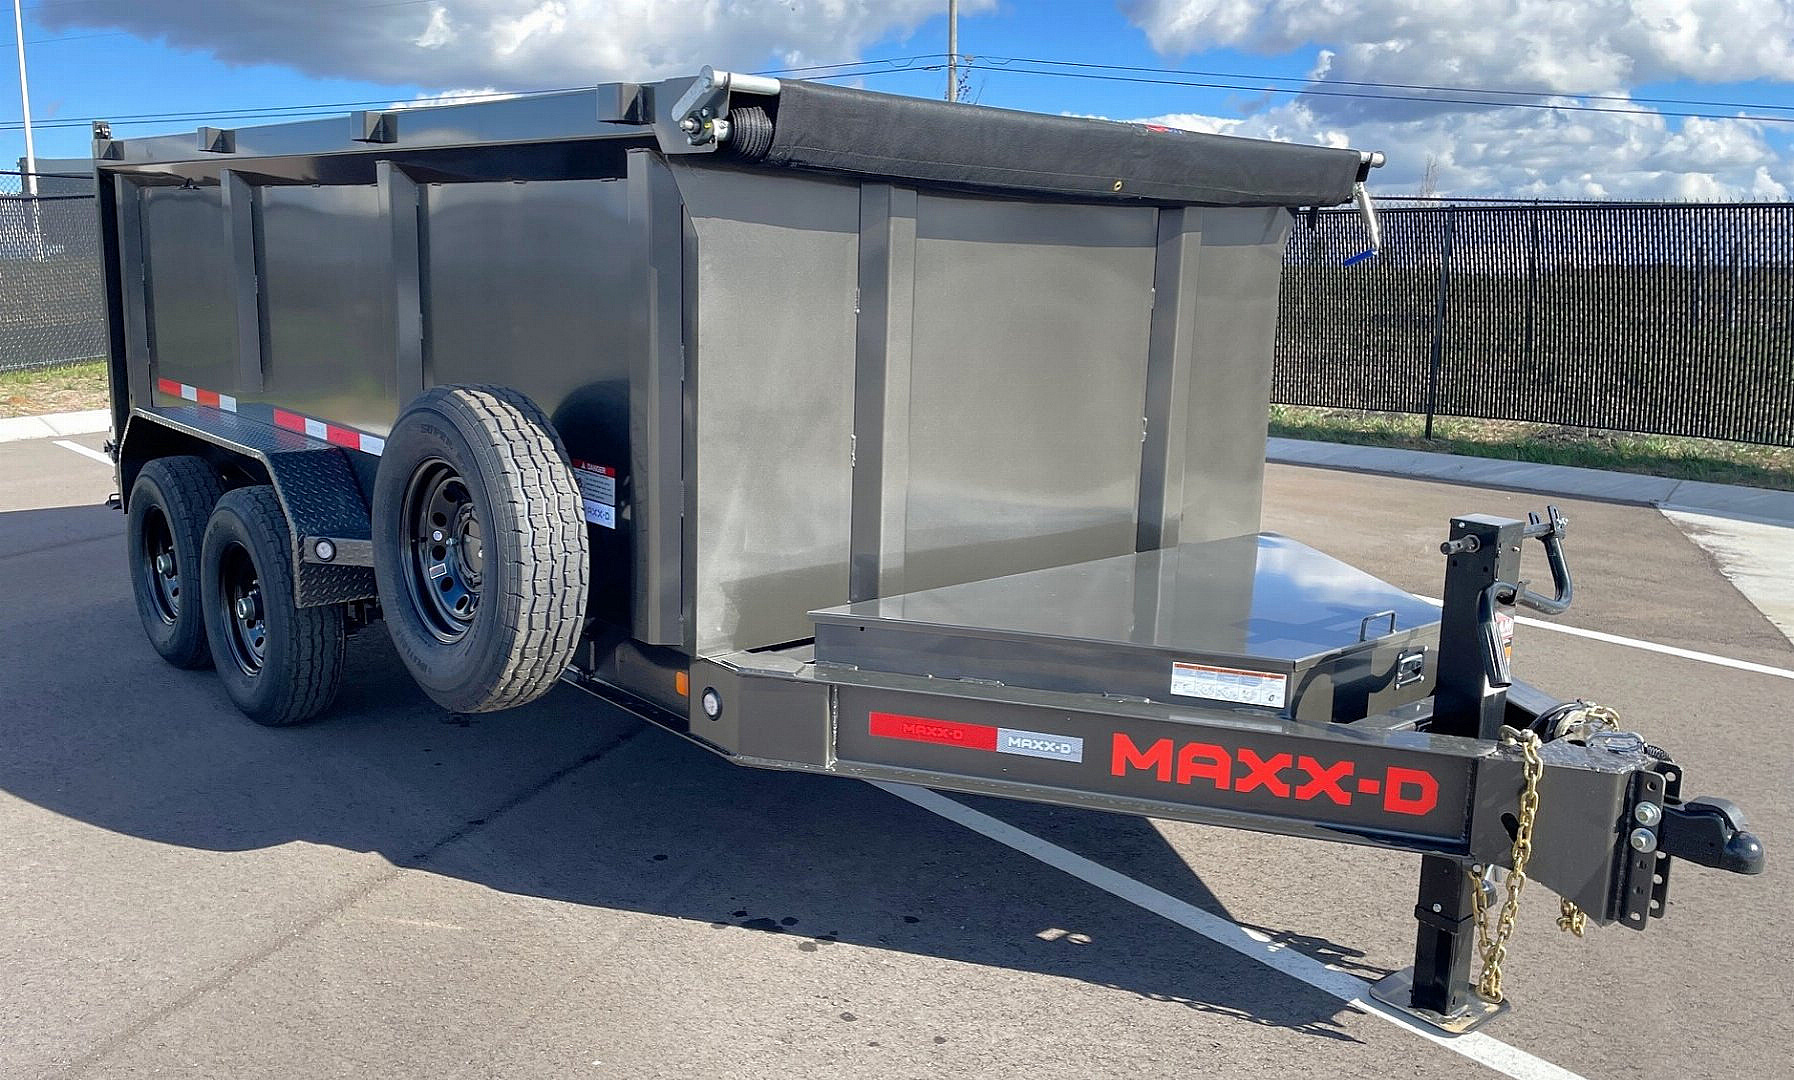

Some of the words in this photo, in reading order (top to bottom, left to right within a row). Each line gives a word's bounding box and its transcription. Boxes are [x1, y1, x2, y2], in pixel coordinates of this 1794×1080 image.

[902, 723, 964, 740] MAXX-D
[1007, 736, 1072, 754] MAXX-D
[1111, 732, 1439, 816] MAXX-D
